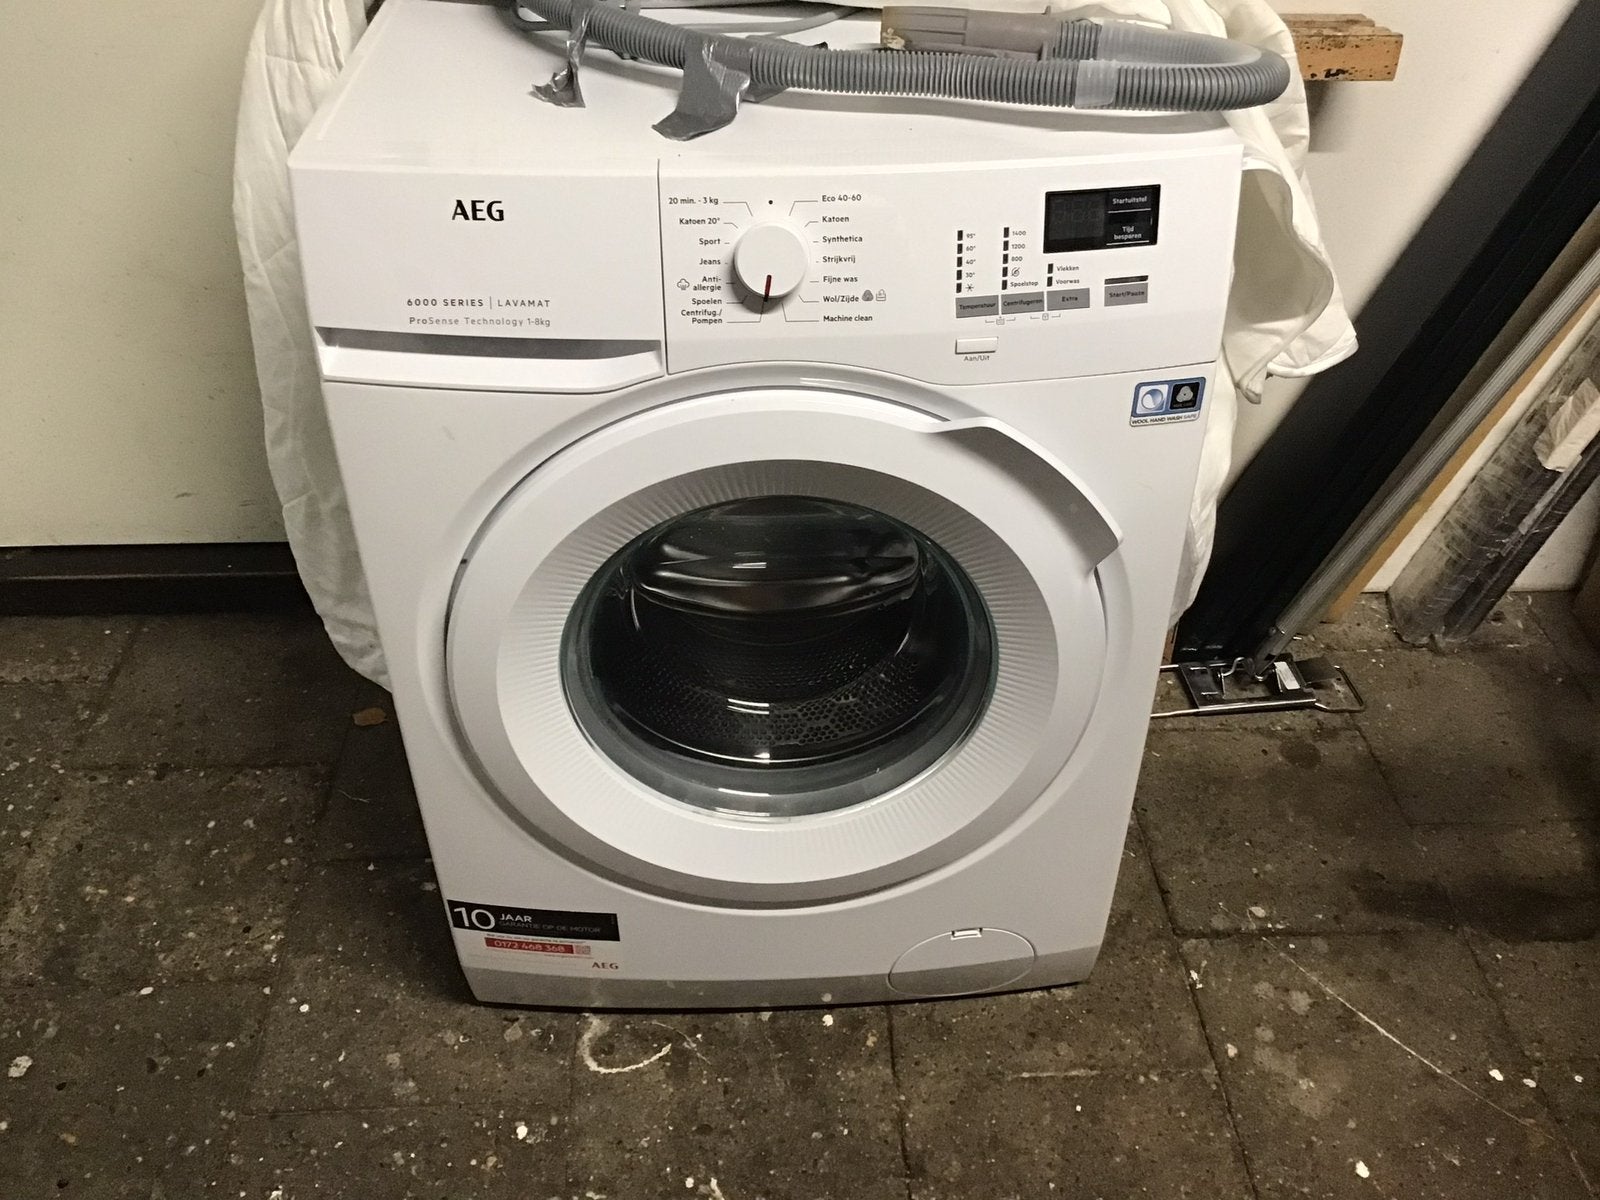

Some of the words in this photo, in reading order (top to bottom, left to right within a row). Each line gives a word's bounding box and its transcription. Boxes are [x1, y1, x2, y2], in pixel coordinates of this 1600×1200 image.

[709, 196, 719, 205] kg
[838, 194, 862, 202] 40-60
[1112, 196, 1148, 204] Startuitstel
[452, 199, 504, 222] AEG
[699, 238, 721, 246] Sport
[822, 235, 863, 244] Synthetica
[822, 255, 856, 264] Strijkvrij
[823, 276, 841, 284] Fijne
[693, 284, 722, 292] allergie
[407, 298, 438, 307] 6000
[443, 299, 484, 307] SERIES
[823, 295, 860, 303] Wol/Zijde
[681, 308, 722, 317] Centrifug./
[409, 316, 459, 325] ProSense
[464, 317, 523, 327] Technology
[527, 318, 551, 328] 1-8kg
[692, 317, 723, 325] Pompen
[454, 907, 496, 930] 10
[500, 913, 532, 923] JAAR
[494, 940, 519, 949] 0172
[592, 962, 619, 970] AEG
